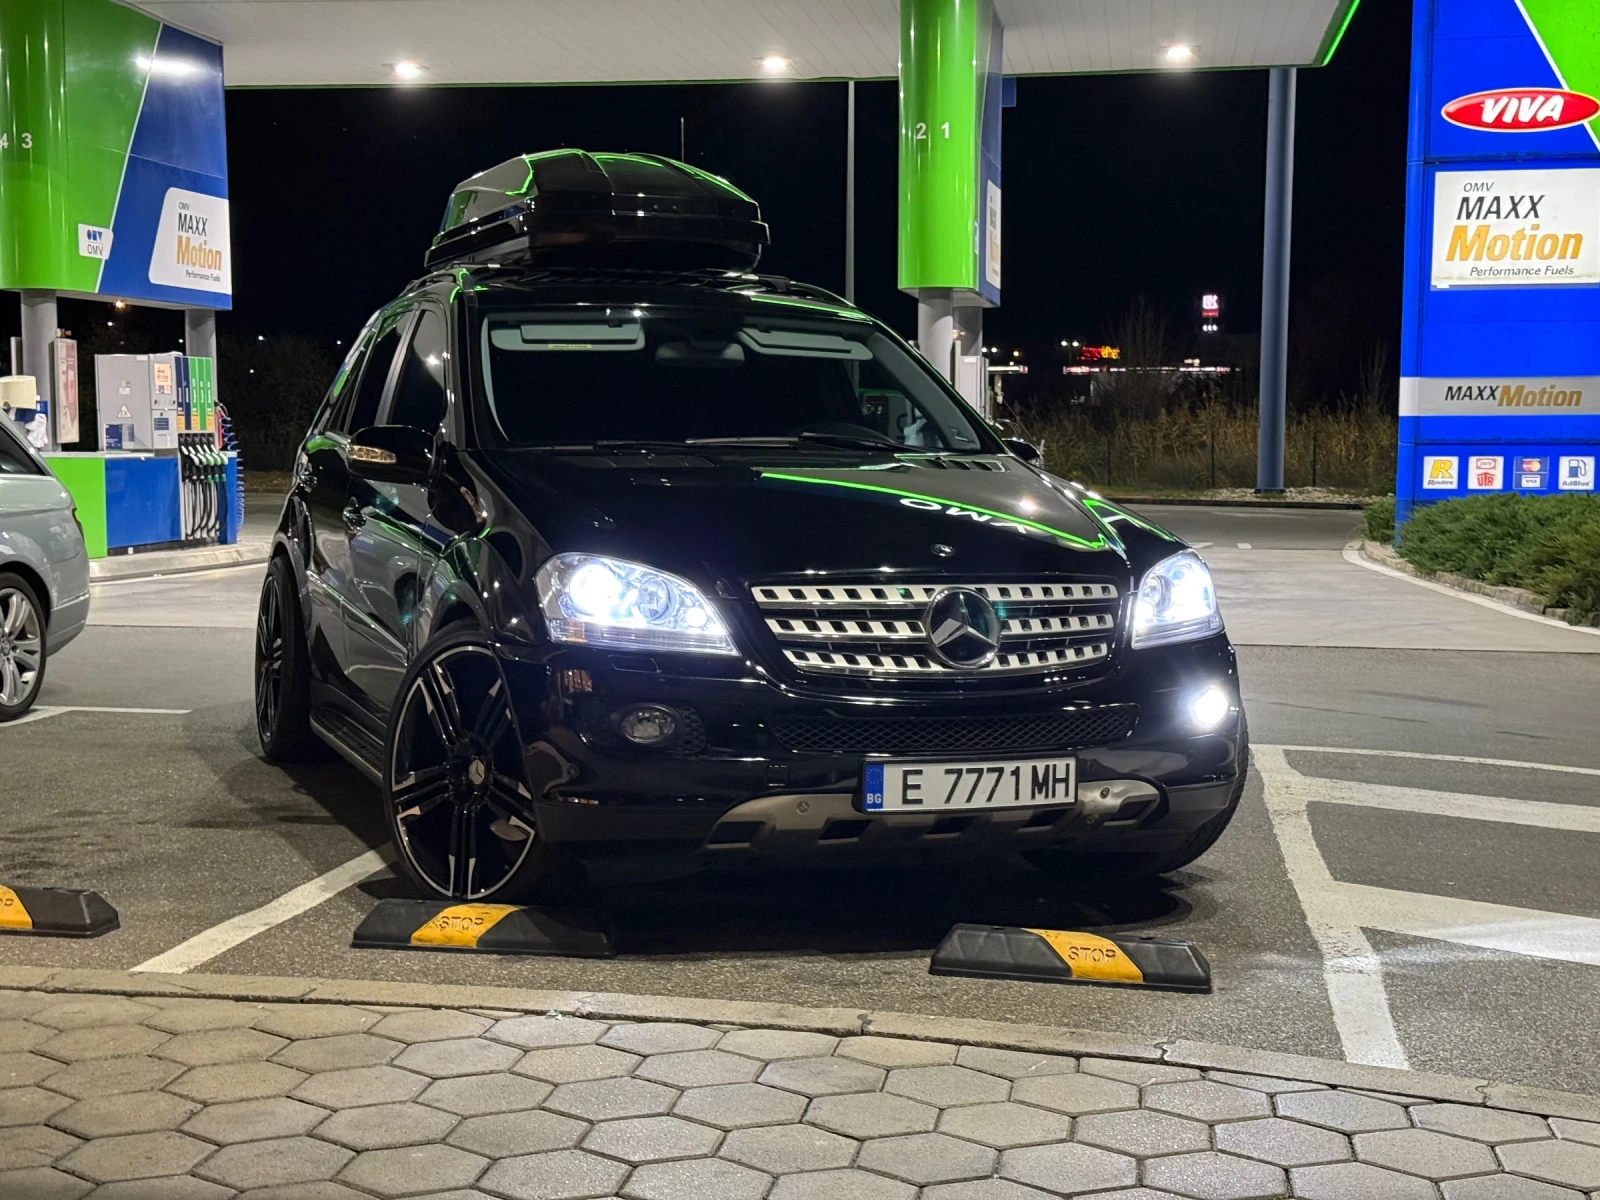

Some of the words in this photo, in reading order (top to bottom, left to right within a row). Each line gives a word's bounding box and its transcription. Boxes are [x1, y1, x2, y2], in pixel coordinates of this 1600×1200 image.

[1480, 94, 1565, 124] VIVA
[915, 122, 927, 140] 2
[941, 121, 950, 139] 1
[0, 132, 9, 149] 4
[21, 132, 33, 149] 3
[1463, 182, 1494, 192] OMV
[178, 201, 190, 211] OMV
[1456, 194, 1546, 220] MAXX
[178, 212, 208, 237] MAXX
[87, 244, 103, 256] OMV
[1445, 223, 1584, 262] Motion
[176, 235, 223, 271] Motion
[1470, 265, 1541, 277] Performance
[1544, 265, 1574, 276] Fuels
[902, 768, 924, 805] E
[866, 793, 882, 804] BG
[439, 916, 484, 930] STOP
[1068, 946, 1117, 962] STOP
